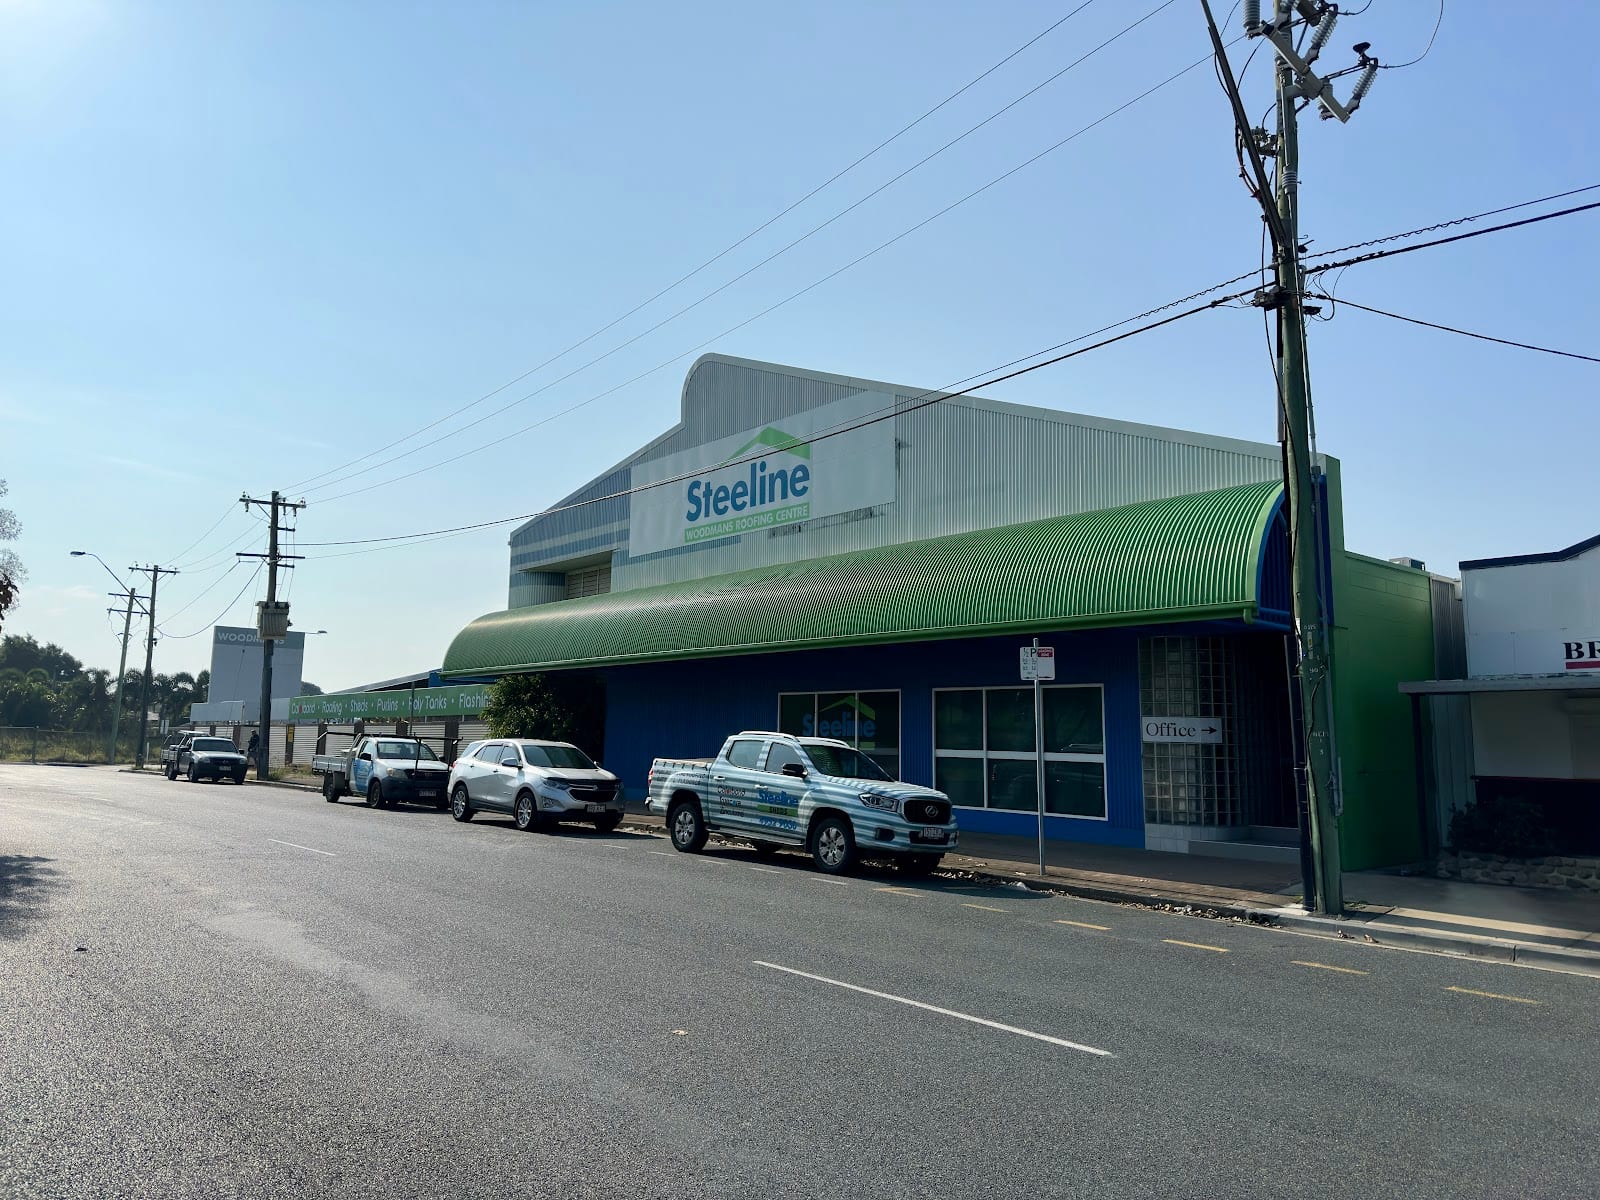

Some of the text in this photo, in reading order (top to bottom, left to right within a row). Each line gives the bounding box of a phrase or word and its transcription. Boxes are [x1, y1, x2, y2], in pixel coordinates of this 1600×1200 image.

[686, 460, 810, 522] Steeline
[686, 505, 809, 541] WOODMANS ROOFING CENTRE
[1030, 647, 1037, 658] P
[322, 700, 343, 716] Roofing
[350, 699, 368, 713] Sheds
[376, 697, 399, 712] Purlins
[425, 693, 448, 710] Tanks
[1146, 722, 1196, 737] Office
[757, 788, 799, 806] Steeline
